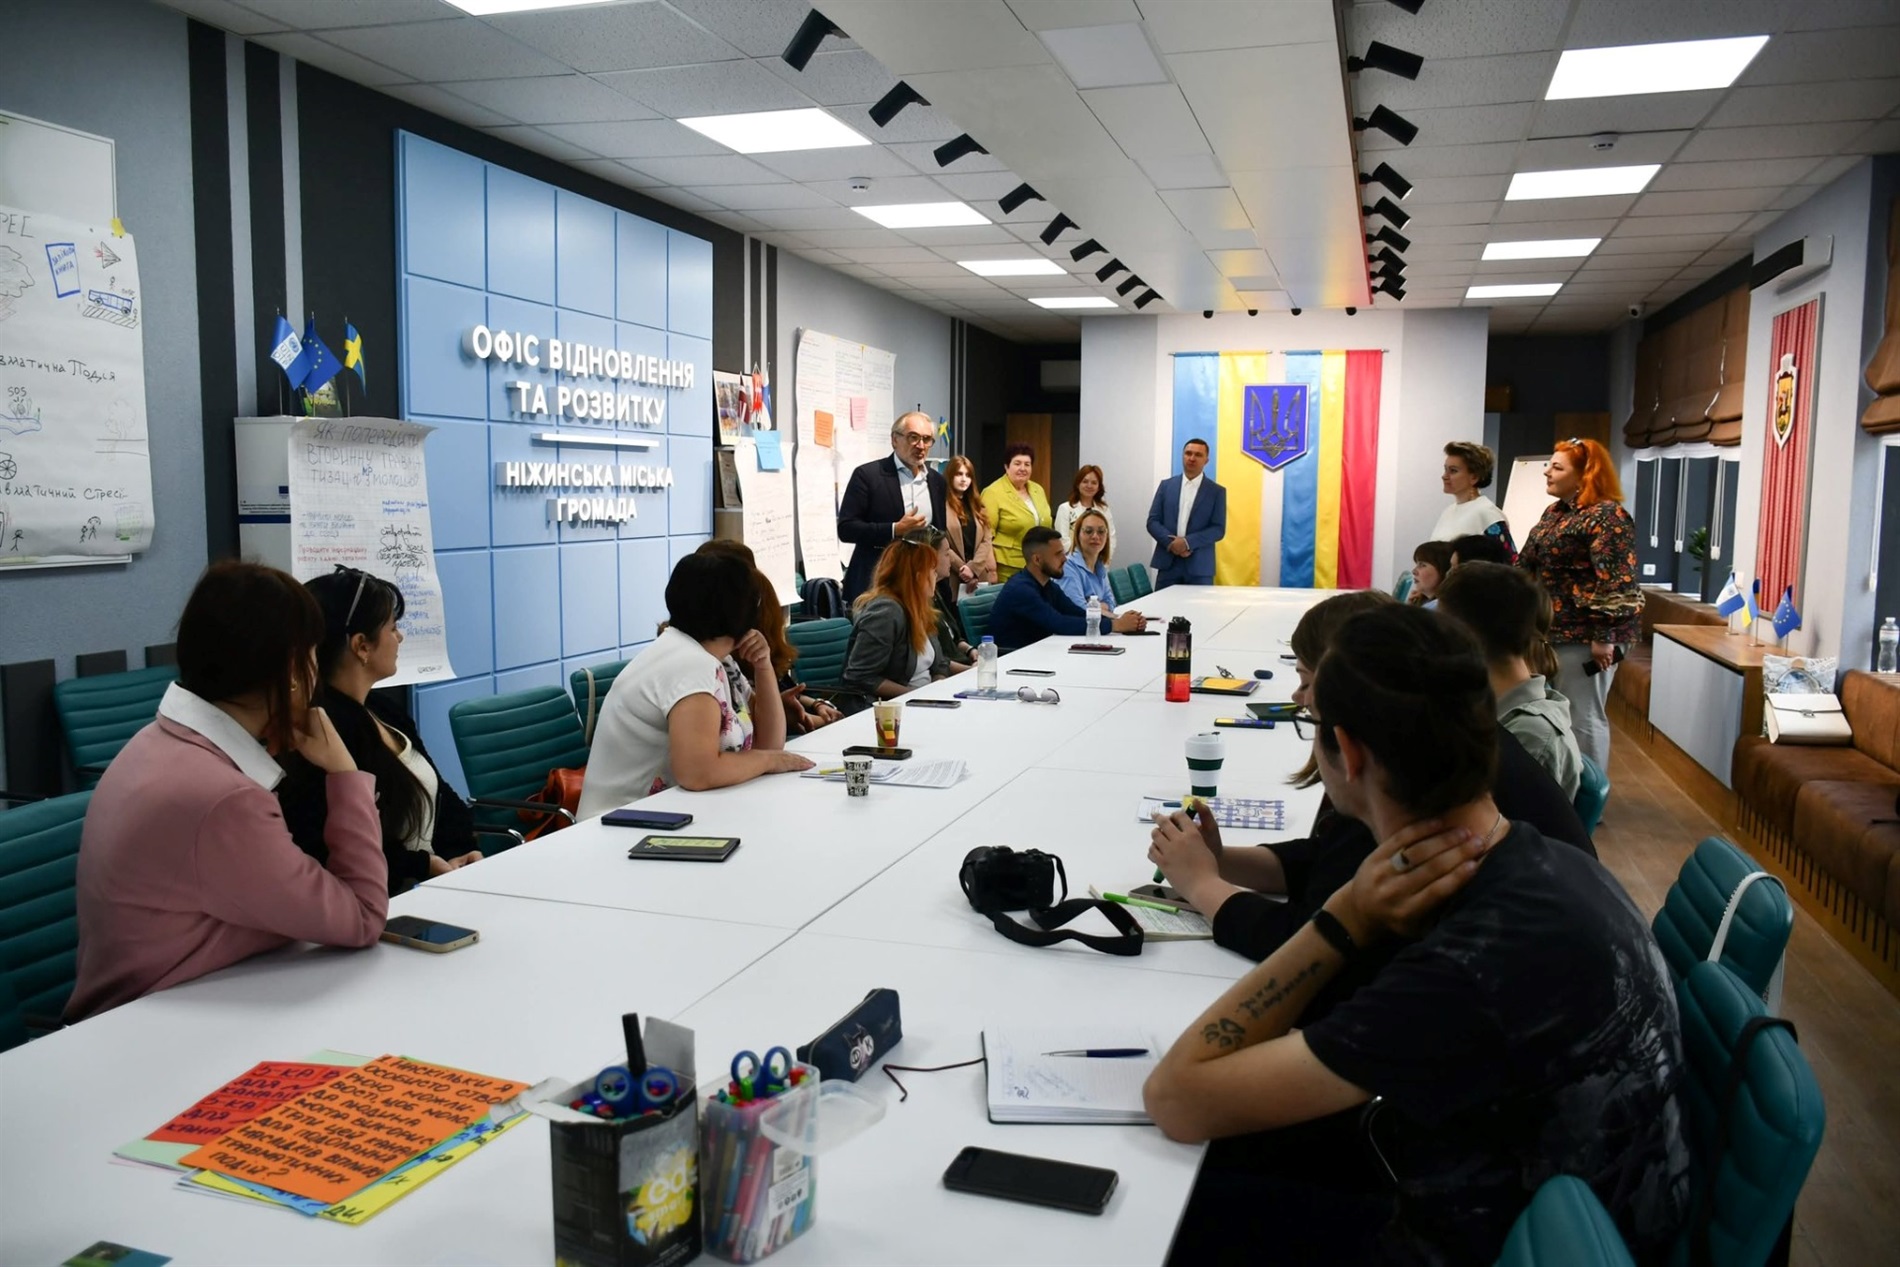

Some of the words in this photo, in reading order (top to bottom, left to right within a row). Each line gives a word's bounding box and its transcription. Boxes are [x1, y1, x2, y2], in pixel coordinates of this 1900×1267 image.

[471, 324, 540, 367] ОФІС
[548, 338, 694, 389] ВІДНОВЛЕННЯ
[7, 386, 27, 397] SOS
[515, 380, 548, 415] ТА
[557, 385, 666, 425] РОЗВИТКУ
[314, 421, 337, 440] ЯК
[505, 461, 615, 487] НІЖИНСЬКА
[619, 463, 675, 487] МІСЬКА
[556, 497, 638, 522] ГРОМАДА
[363, 1064, 451, 1093] ОСОБИСТО
[494, 1082, 515, 1094] Я
[278, 1105, 325, 1127] ТАТИ
[293, 1098, 350, 1121] МОГЛА
[306, 1089, 340, 1102] ДА
[340, 1099, 421, 1128] ЛЮДИНА
[380, 1097, 420, 1112] ЩОБ
[253, 1115, 294, 1132] ДЛЯ
[293, 1128, 399, 1164] ПОДОЛАННЯ
[217, 1135, 352, 1185] ТРАВМАТИЧНИХ
